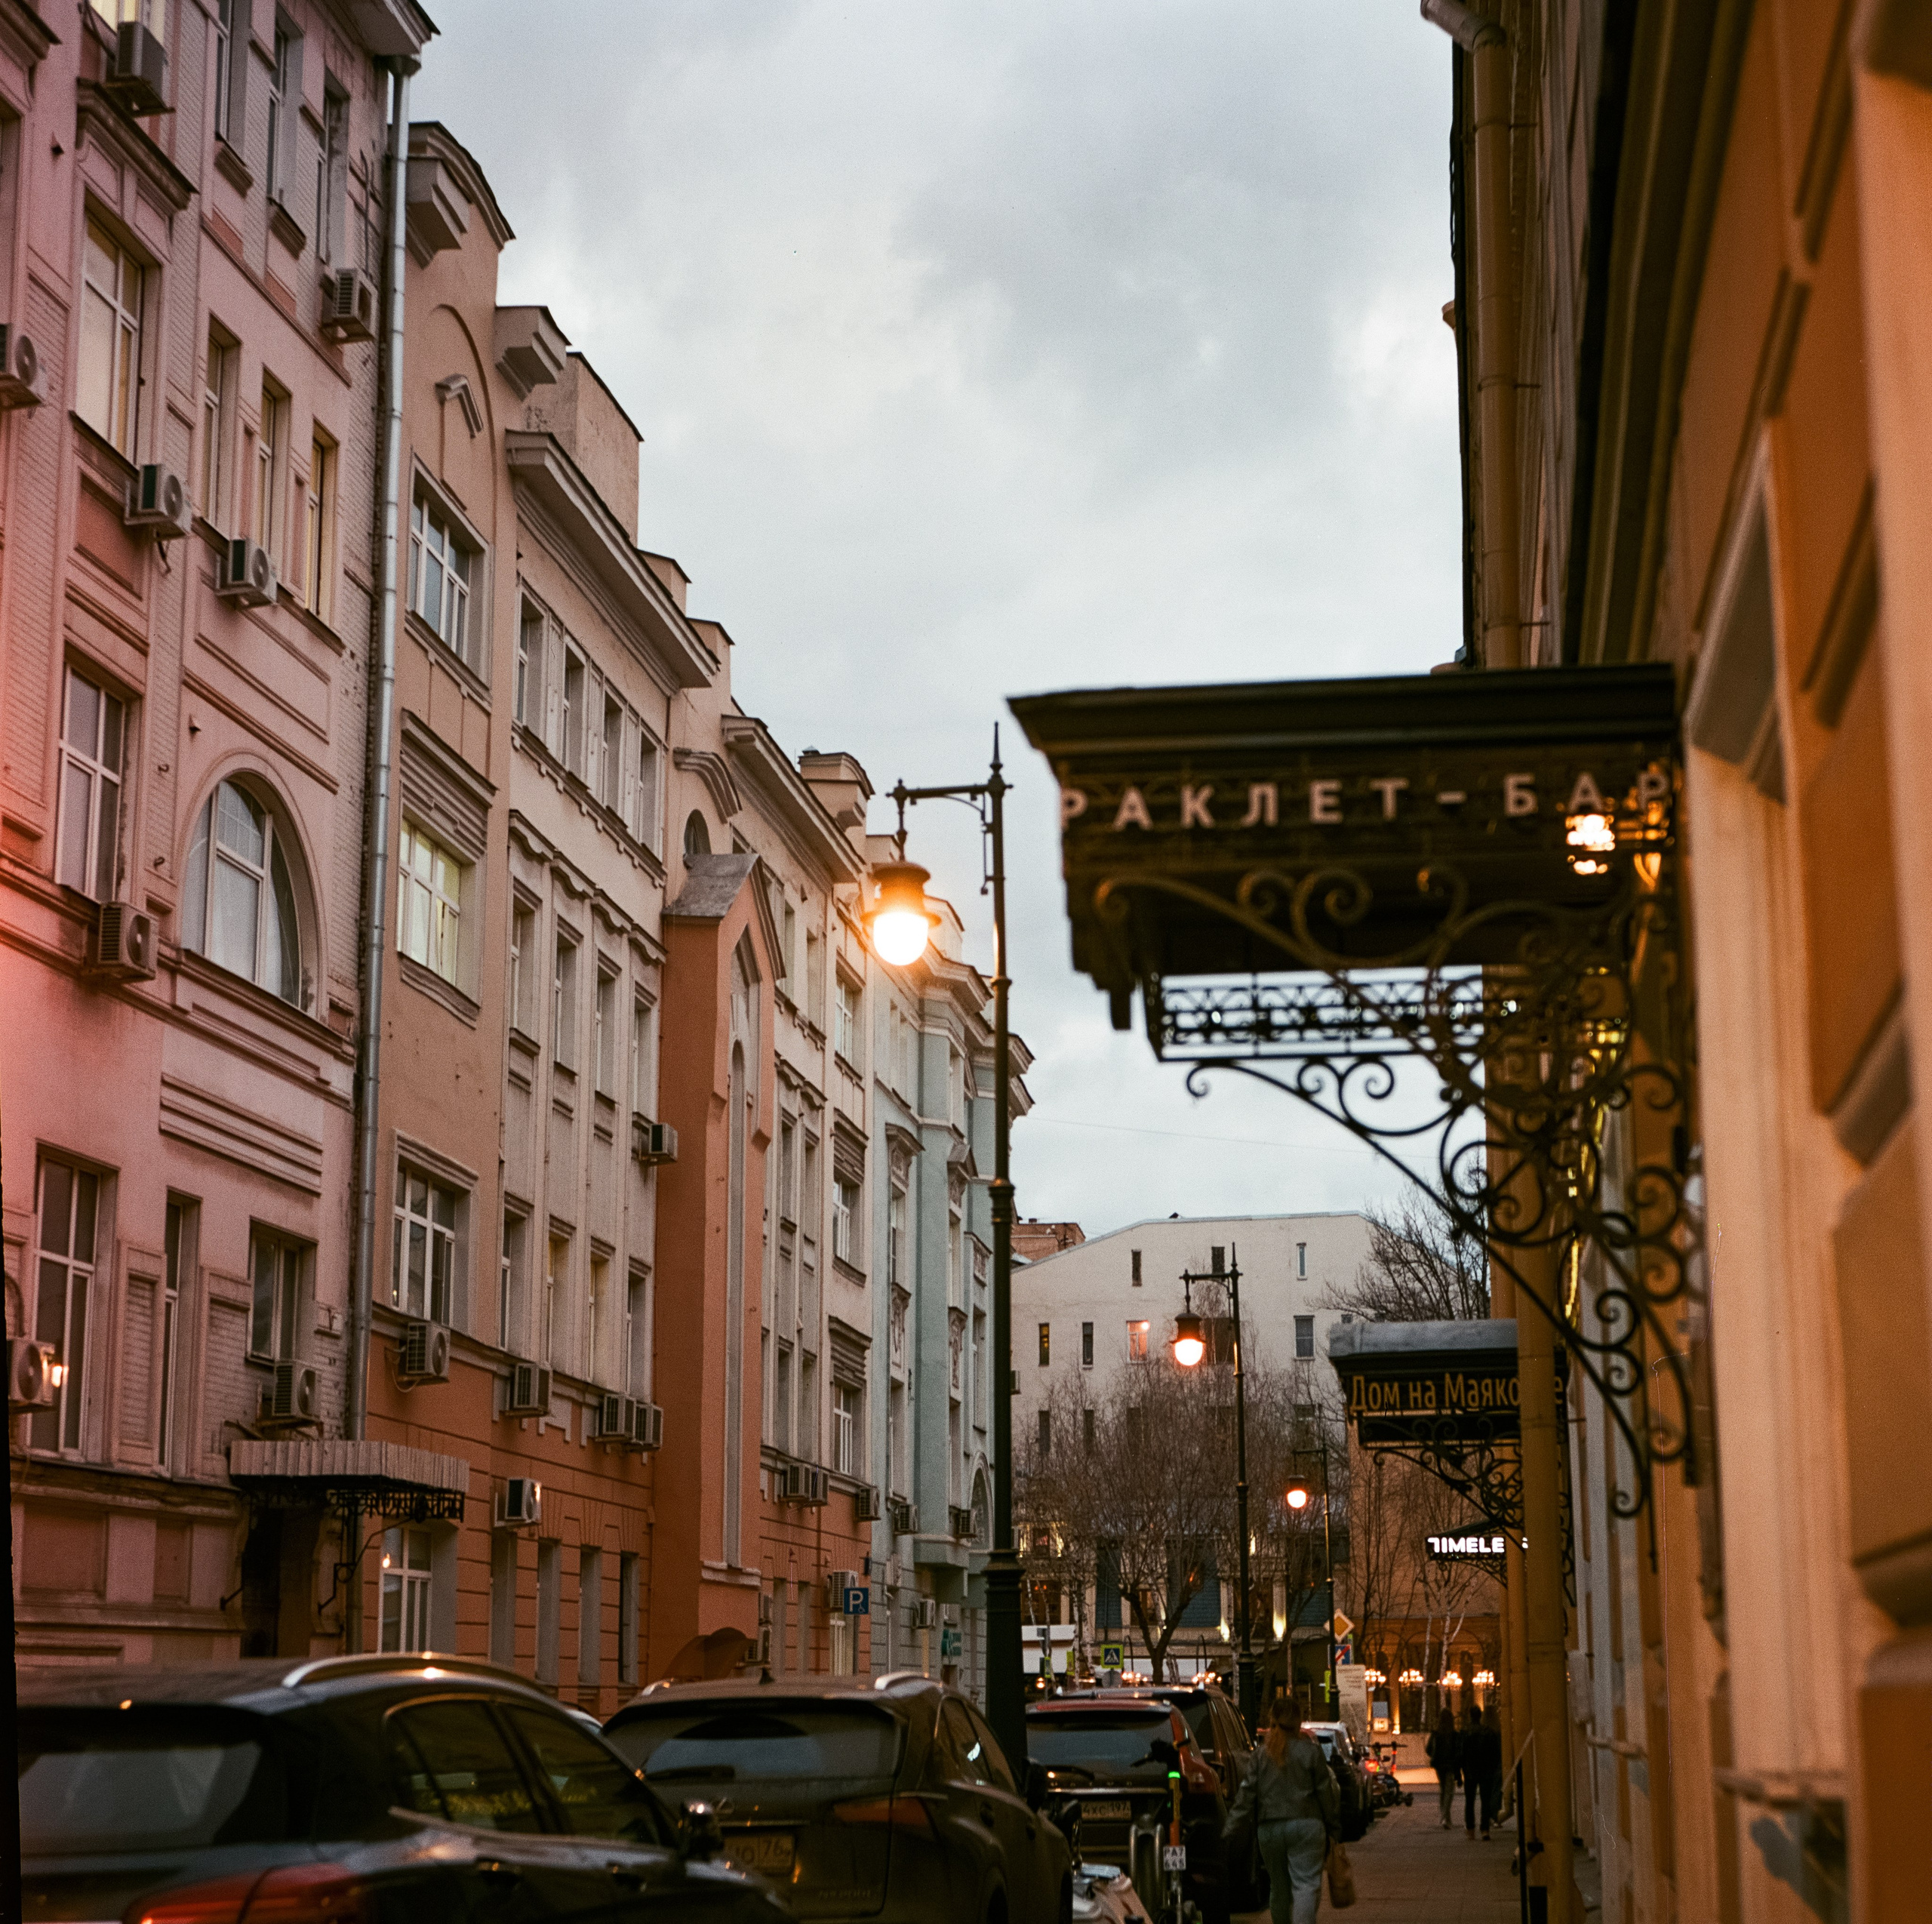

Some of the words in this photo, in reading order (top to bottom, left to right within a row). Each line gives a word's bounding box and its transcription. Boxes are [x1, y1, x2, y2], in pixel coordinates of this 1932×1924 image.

[1061, 771, 1671, 830] РАКЛЕТ-БАР
[1350, 1375, 1400, 1415] Дом
[1408, 1380, 1436, 1408] на
[1444, 1372, 1564, 1408] Маякое
[849, 1590, 864, 1612] P
